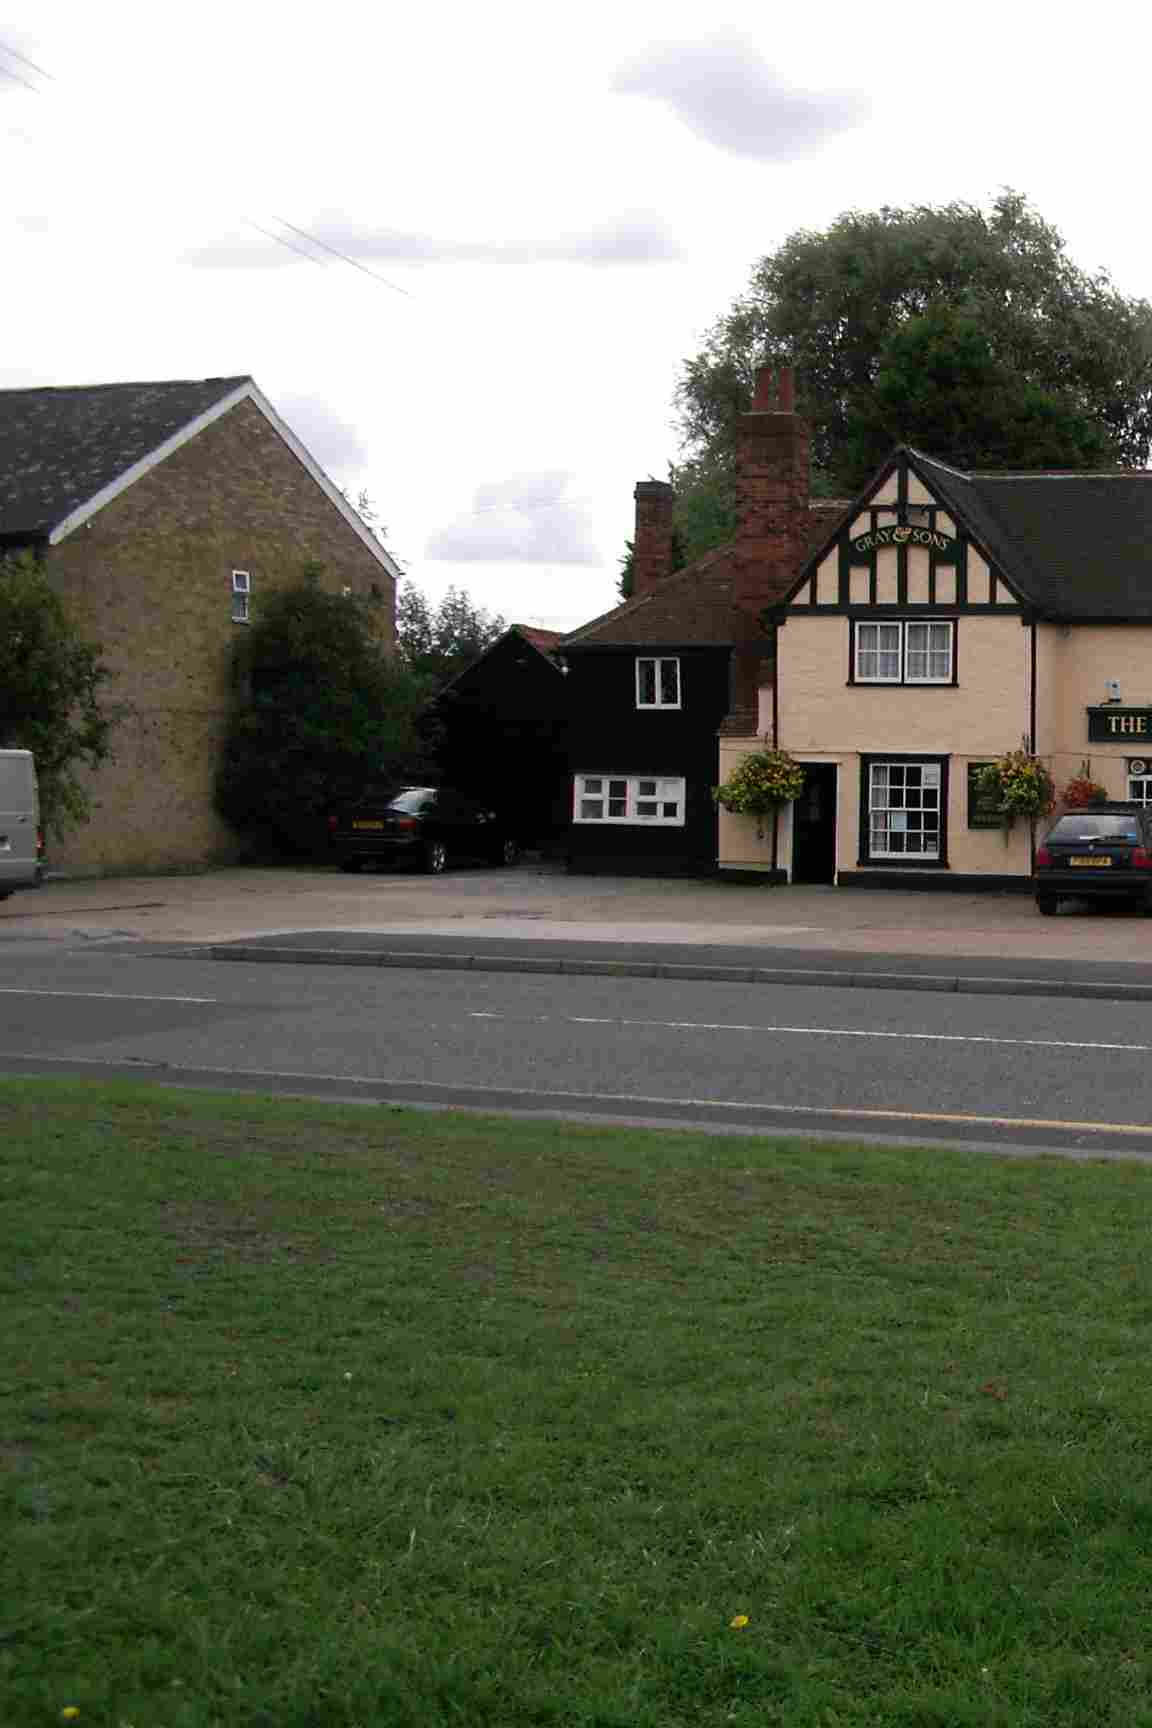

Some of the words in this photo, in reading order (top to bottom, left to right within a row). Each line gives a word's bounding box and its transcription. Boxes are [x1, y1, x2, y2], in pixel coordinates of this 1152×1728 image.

[856, 530, 891, 552] GRAY
[912, 529, 949, 551] SONS
[1107, 715, 1148, 734] THE
